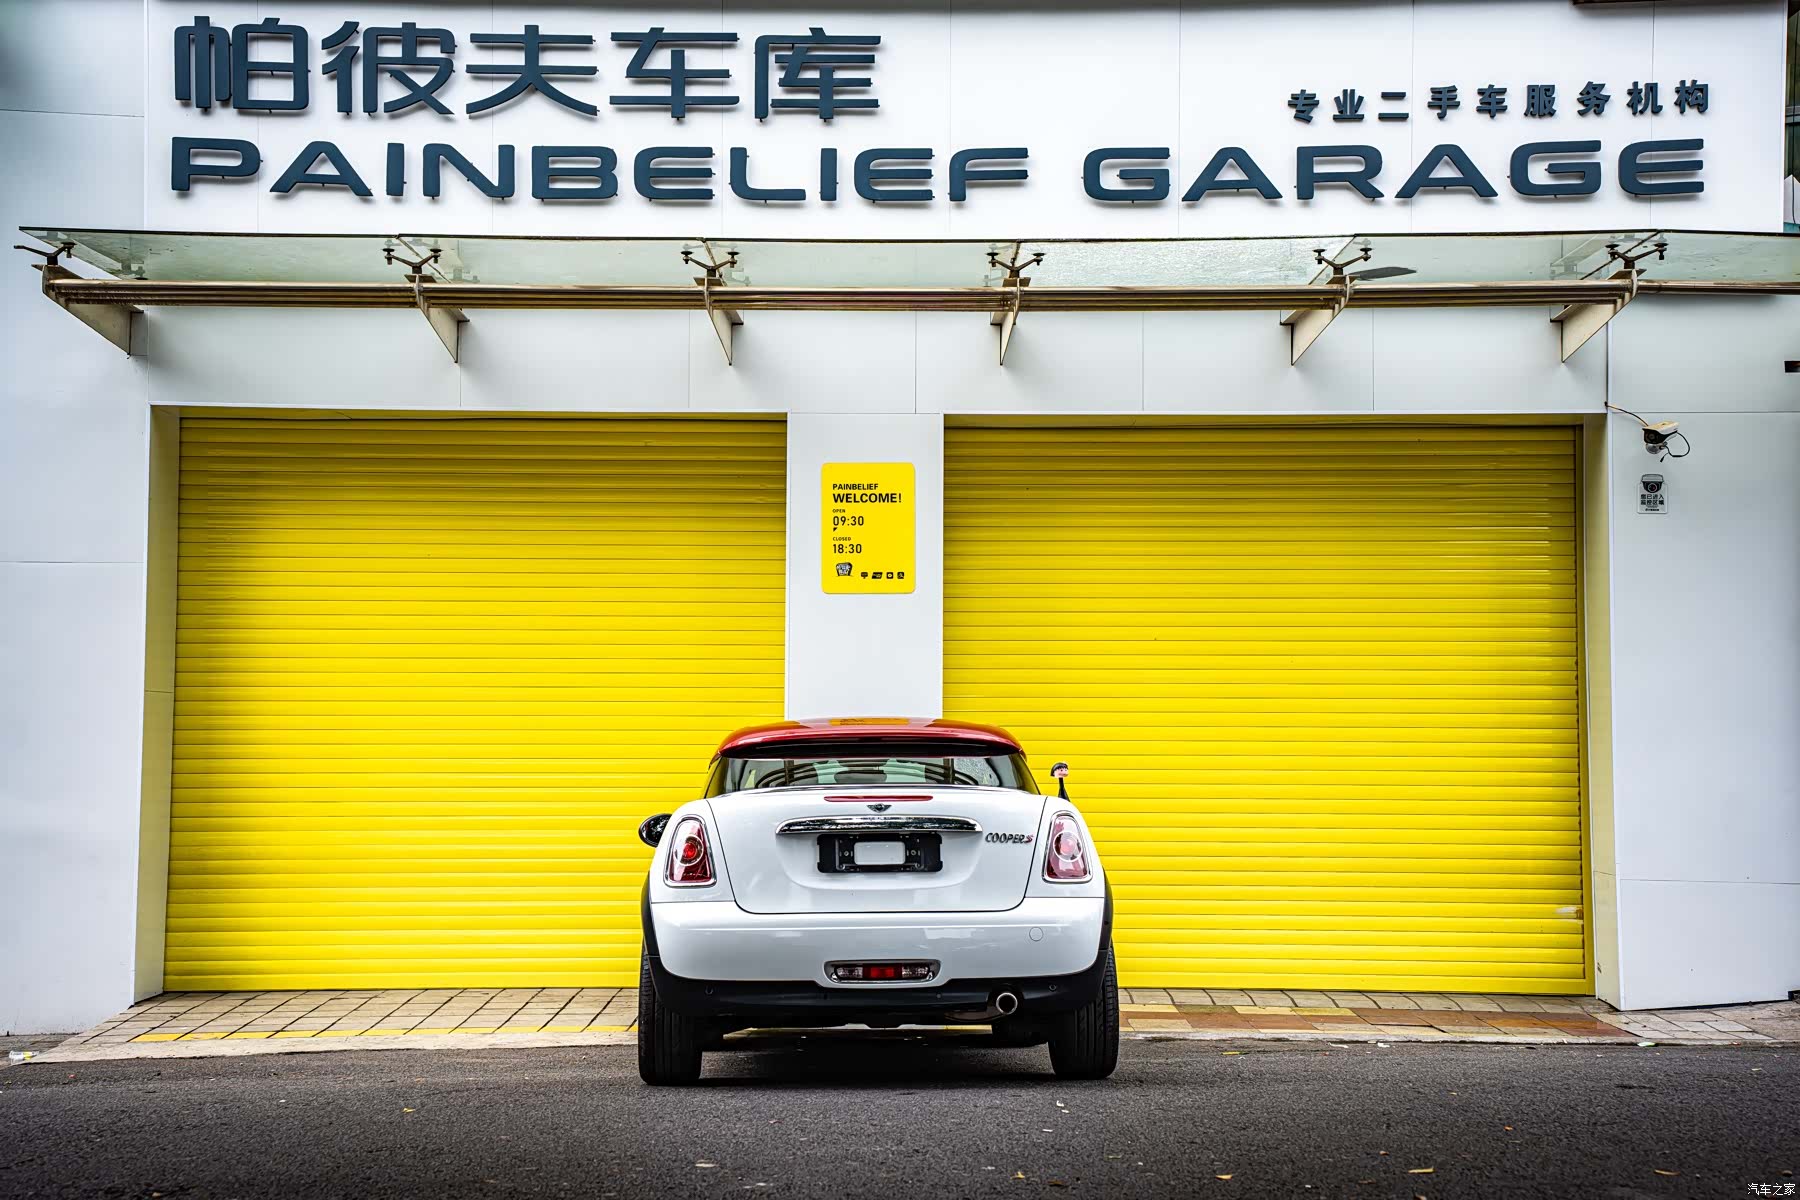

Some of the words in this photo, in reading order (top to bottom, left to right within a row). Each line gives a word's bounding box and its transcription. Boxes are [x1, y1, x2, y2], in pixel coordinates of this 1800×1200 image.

[174, 16, 882, 119] 帕彼夫车库
[1287, 79, 1710, 123] 专业二手车服务机构
[172, 136, 1029, 204] PAINBELIEF
[1082, 139, 1704, 203] GARAGE
[832, 493, 902, 503] WELCOME!
[832, 516, 864, 526] 09:30
[833, 544, 862, 554] 18:30
